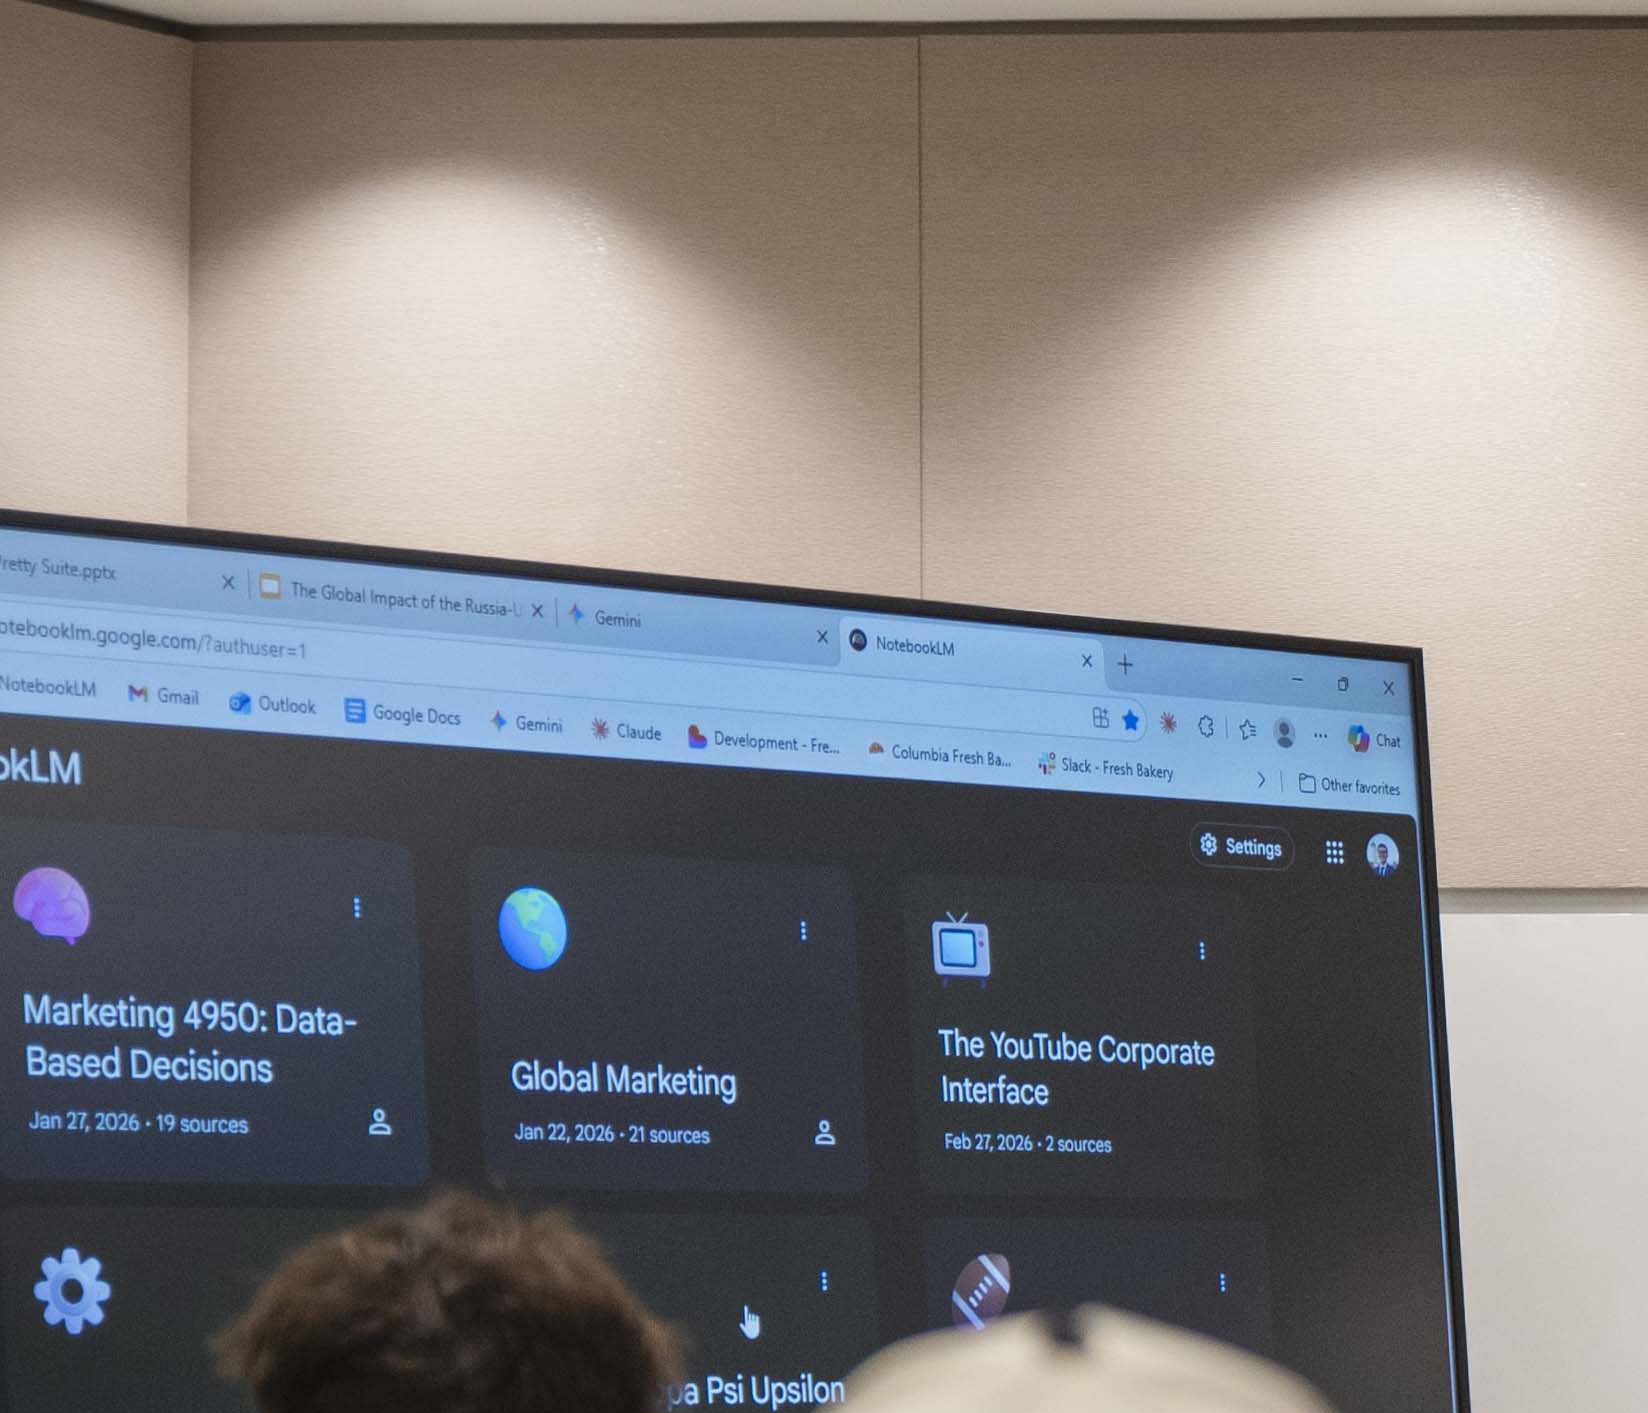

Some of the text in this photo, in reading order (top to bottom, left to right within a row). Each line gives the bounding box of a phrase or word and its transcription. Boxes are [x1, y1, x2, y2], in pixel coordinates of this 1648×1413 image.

[42, 559, 117, 581] Suite.pptx
[292, 581, 317, 599] The
[321, 584, 365, 603] Global
[371, 588, 418, 610] Impact
[423, 594, 436, 609] of
[440, 595, 462, 612] the
[595, 610, 641, 628] Gemini
[877, 636, 955, 656] NotebookLM
[158, 688, 199, 705] Gmail
[259, 696, 316, 715] Outlook
[373, 705, 461, 726] Google Docs
[516, 715, 562, 733] Gemini
[617, 723, 661, 741] Claude
[715, 730, 798, 752] Development
[1376, 733, 1400, 749] Chat
[892, 744, 949, 764] Columbia
[953, 749, 984, 766] Fresh
[1062, 756, 1173, 783] Slack Fresh Bakery
[1321, 777, 1400, 796] Other favorites
[1226, 839, 1281, 860] Settings
[23, 993, 357, 1037] Marketing 4950: Data-
[938, 1027, 1215, 1070] The YouTube Corporate
[27, 1045, 272, 1083] Based Decisions
[512, 1059, 736, 1105] Global Marketing
[942, 1075, 1048, 1106] Interface
[29, 1111, 249, 1135] Jan 27, 2026 19 sources
[515, 1123, 710, 1144] Jan 22, 2026 21 sources
[945, 1132, 1112, 1153] Feb 27, 2026 2 sources
[707, 1373, 744, 1404] Psi
[751, 1373, 845, 1411] Upsilon
